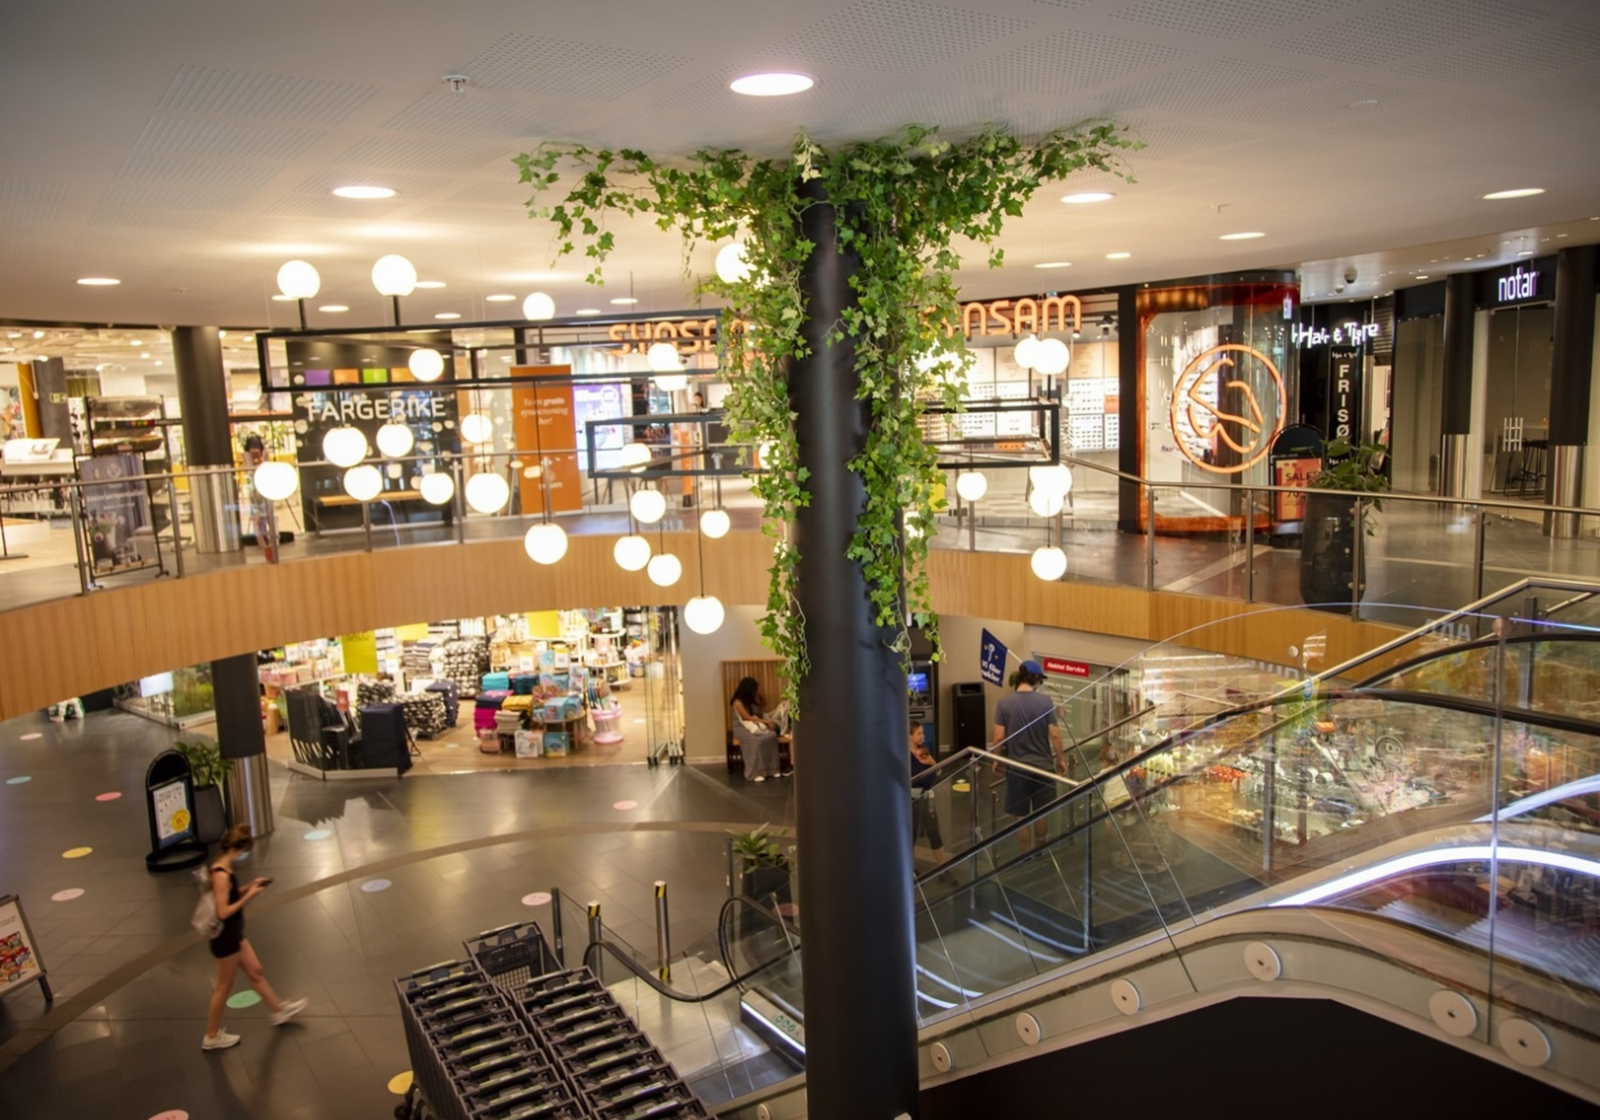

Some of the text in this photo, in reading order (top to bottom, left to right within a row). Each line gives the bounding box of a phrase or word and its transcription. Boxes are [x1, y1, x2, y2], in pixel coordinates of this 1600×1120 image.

[1498, 266, 1538, 302] notar
[1299, 322, 1330, 349] Hair
[1333, 327, 1343, 344] &
[307, 397, 446, 422] FARGERIKE
[1336, 364, 1350, 438] FRISØ
